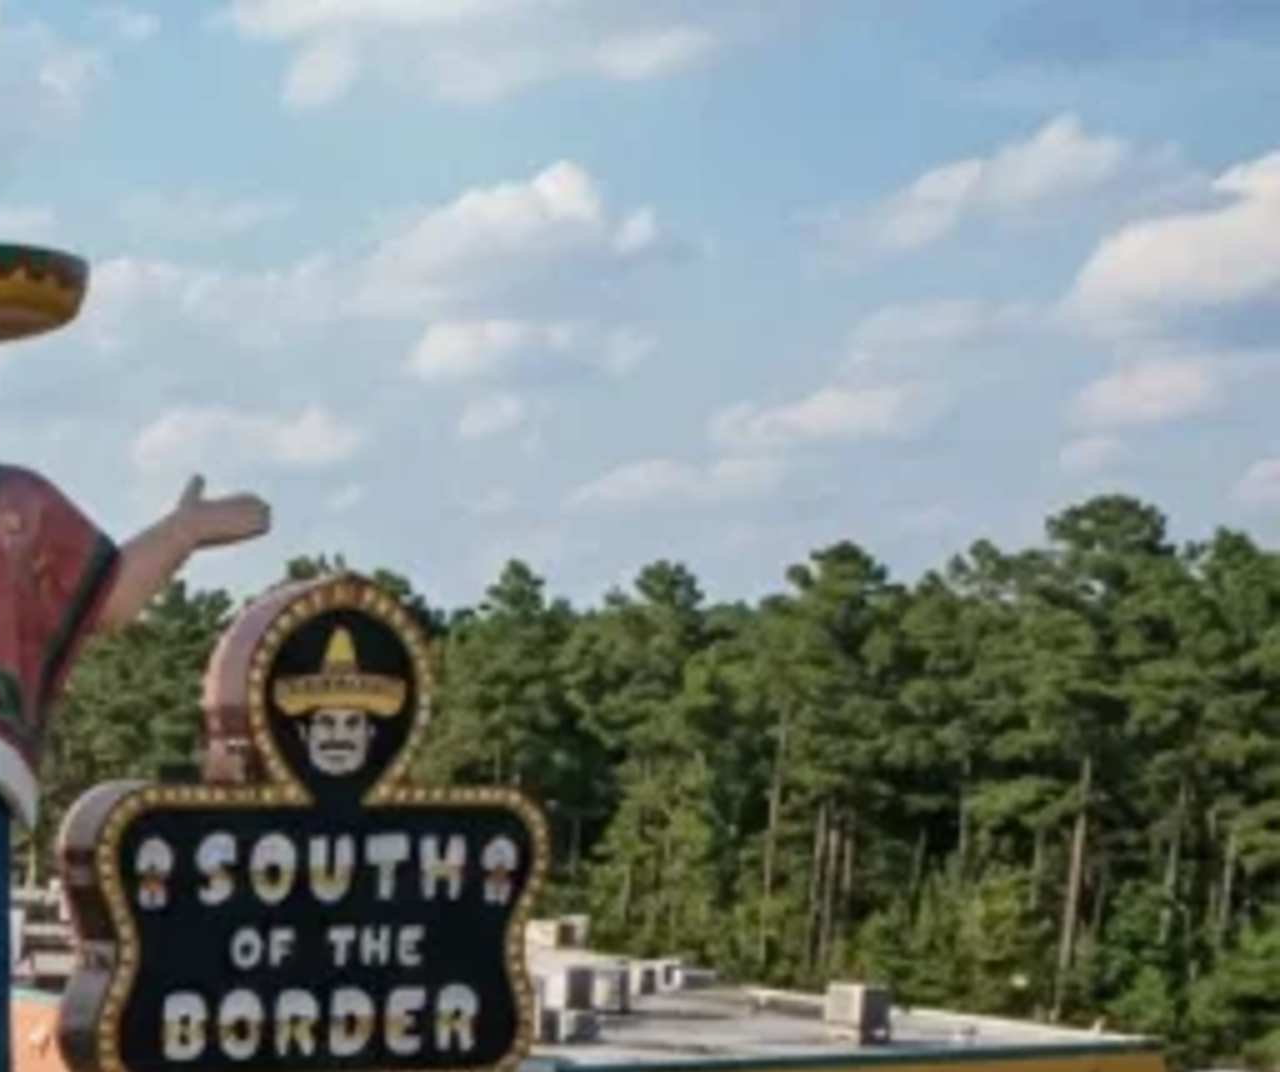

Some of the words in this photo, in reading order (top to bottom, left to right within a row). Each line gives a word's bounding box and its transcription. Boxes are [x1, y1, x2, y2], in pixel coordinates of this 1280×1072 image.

[195, 832, 467, 905] SOUTH
[231, 927, 295, 969] OF
[327, 925, 424, 967] THE
[163, 984, 478, 1061] BORDER
